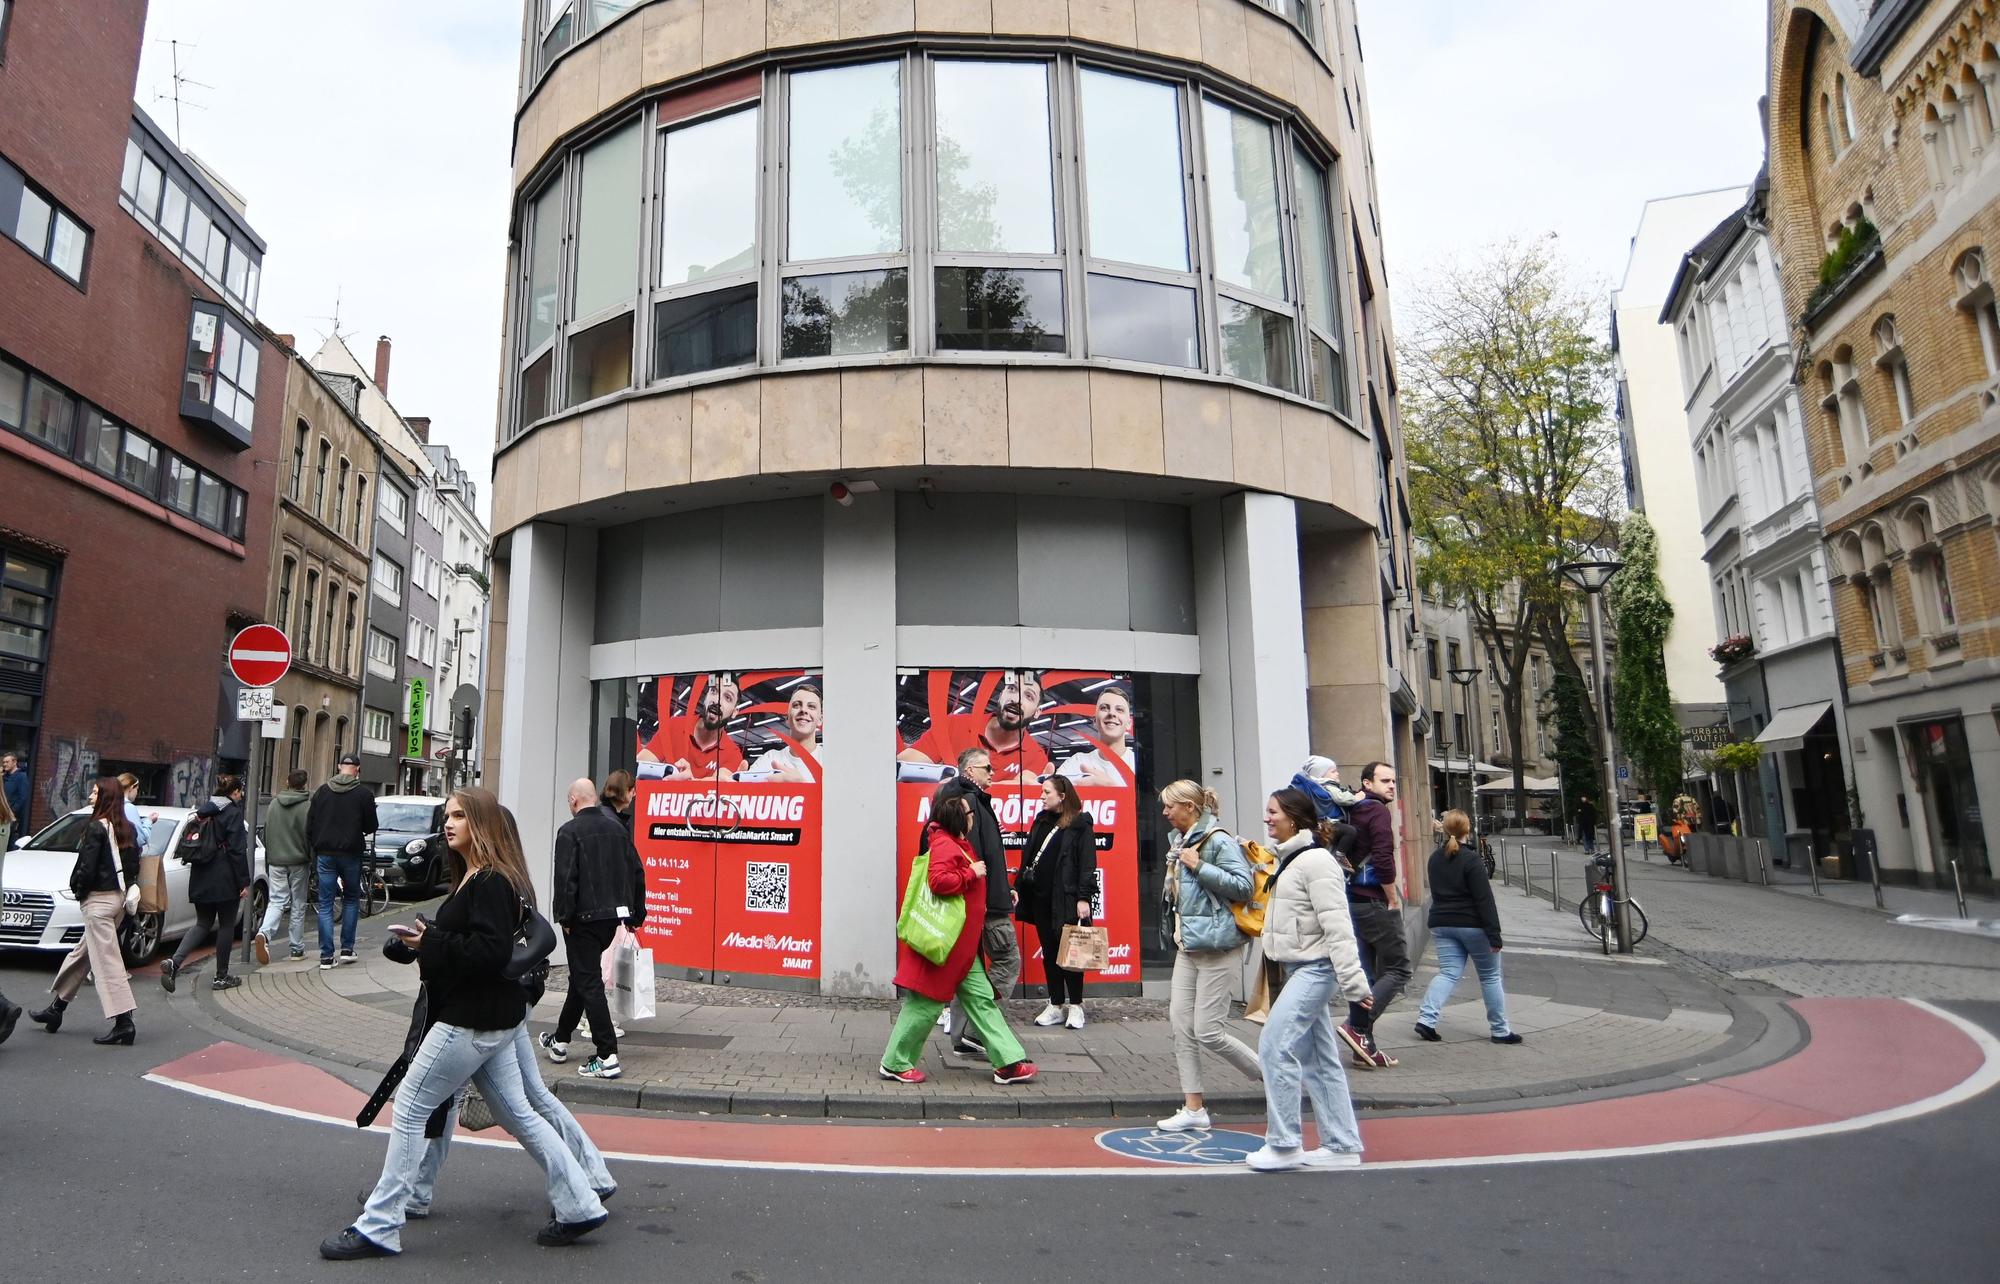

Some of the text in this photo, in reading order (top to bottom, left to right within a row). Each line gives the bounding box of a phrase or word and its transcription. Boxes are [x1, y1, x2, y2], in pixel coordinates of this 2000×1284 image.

[1691, 727, 1726, 735] URBAN
[647, 789, 805, 821] NEUERÖFFNUNG
[770, 832, 794, 842] Smart
[646, 856, 689, 869] Ab 14.11.24
[645, 890, 679, 902] Werde Teil
[645, 903, 693, 915] unseres Teams
[13, 912, 32, 924] 999
[658, 915, 682, 926] bewirb
[644, 925, 658, 935] dich
[722, 932, 813, 953] Media Markt
[1107, 943, 1131, 958] arkt
[782, 957, 813, 970] SMART
